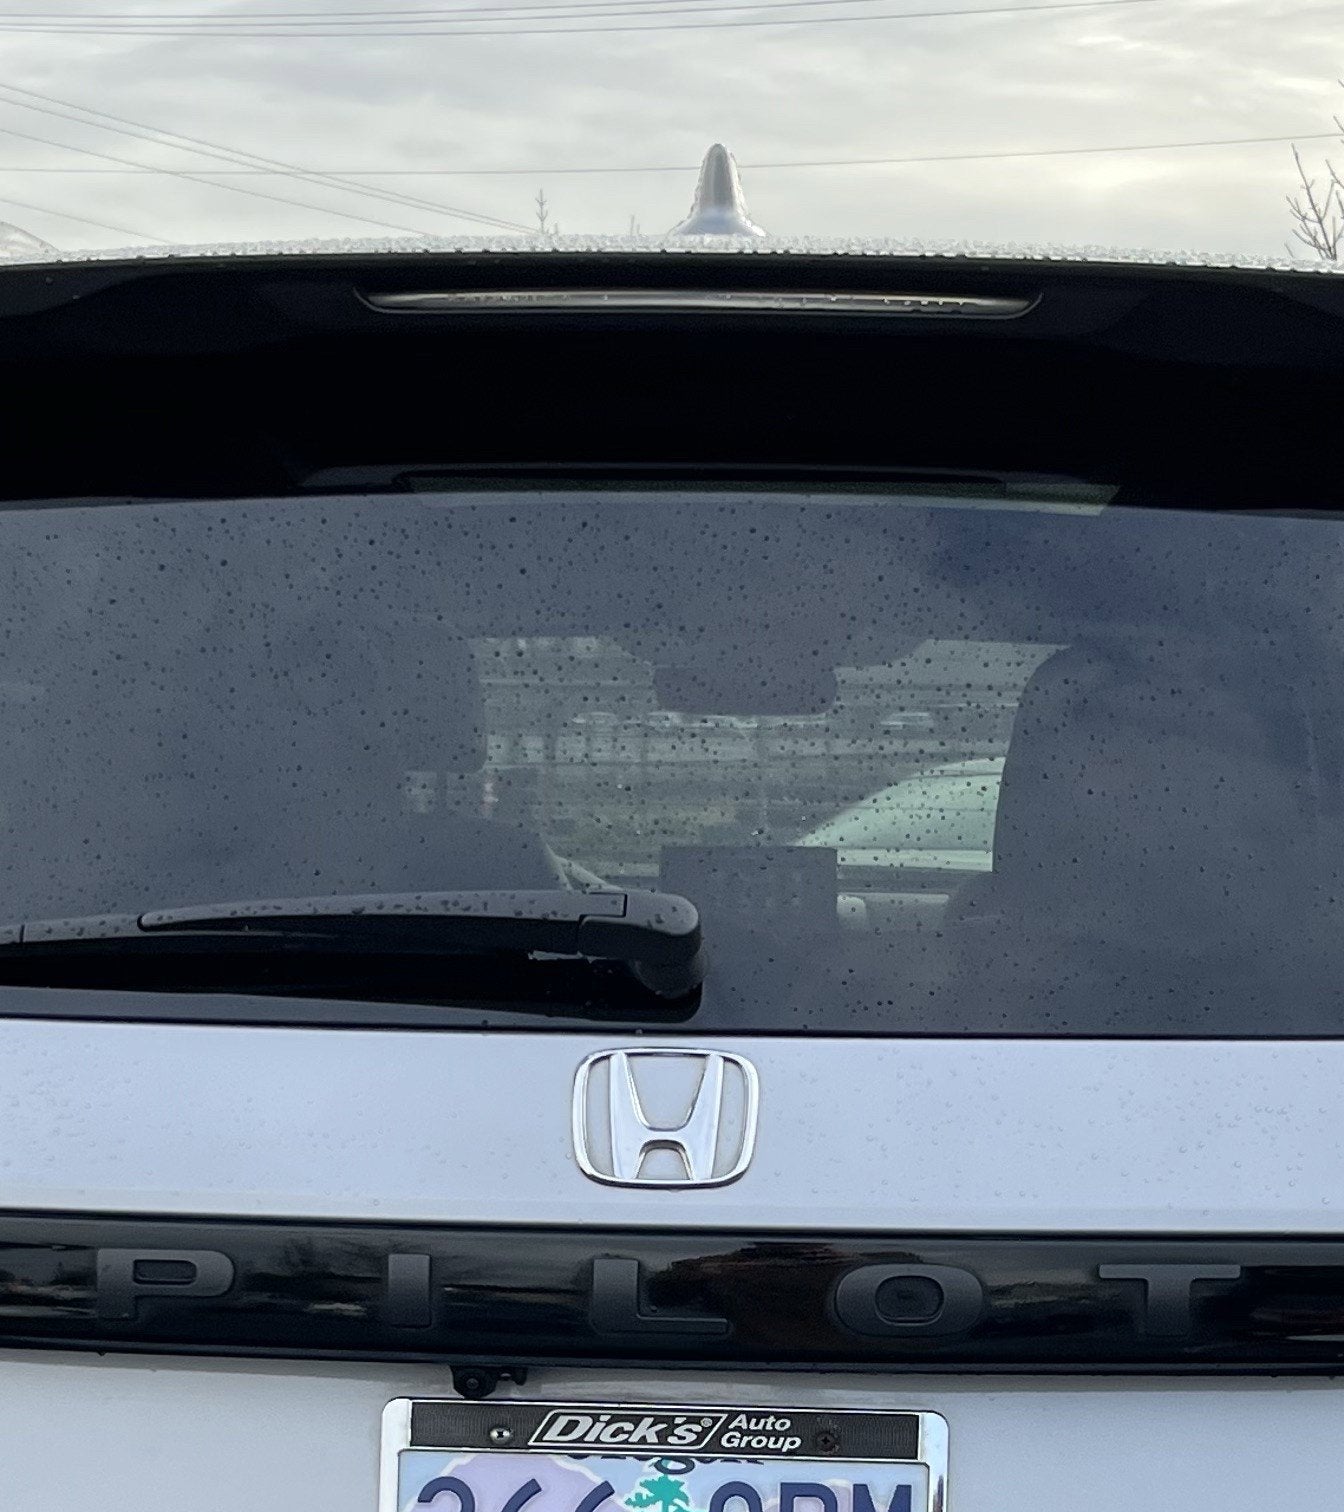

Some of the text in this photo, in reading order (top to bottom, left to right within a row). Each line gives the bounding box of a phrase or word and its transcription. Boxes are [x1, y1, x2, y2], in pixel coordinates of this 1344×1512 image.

[95, 1247, 1242, 1338] PILOT
[543, 1415, 702, 1445] Dick's
[728, 1414, 791, 1432] Auto
[720, 1431, 802, 1452] Group
